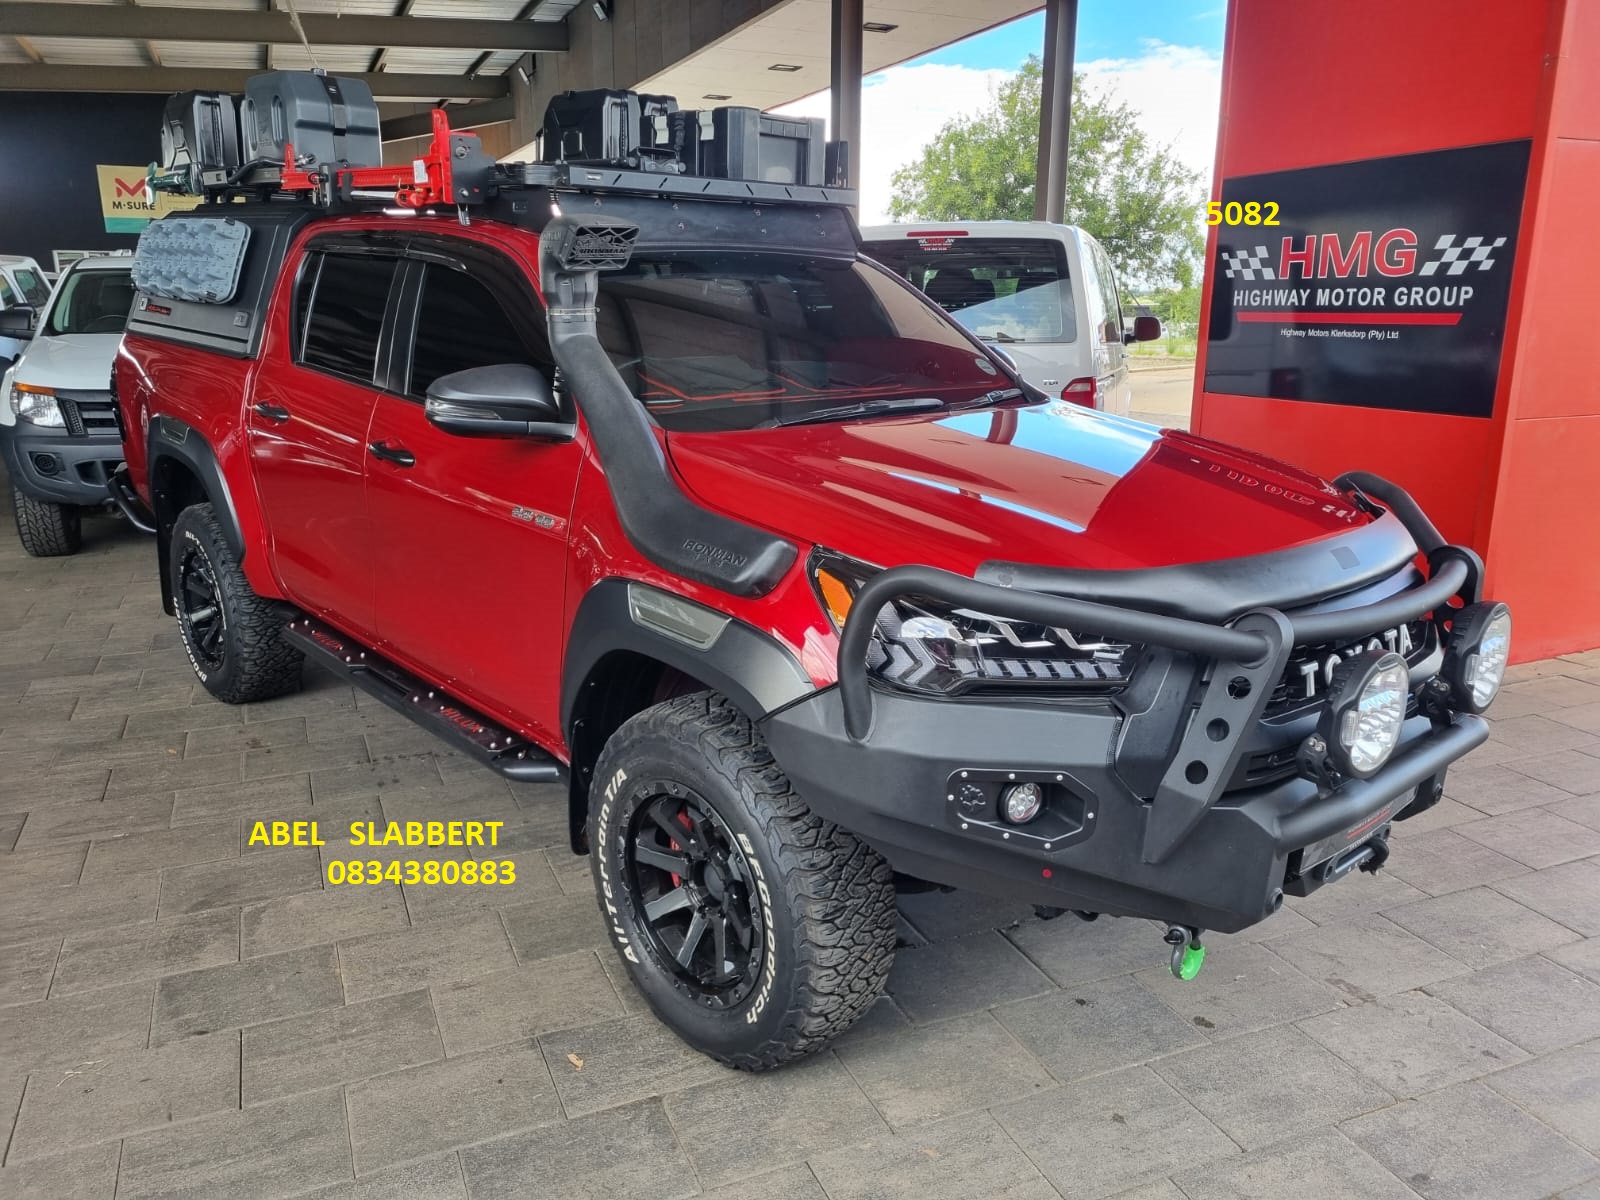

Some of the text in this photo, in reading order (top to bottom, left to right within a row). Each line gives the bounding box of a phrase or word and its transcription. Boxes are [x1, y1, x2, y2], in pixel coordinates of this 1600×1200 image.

[1278, 228, 1418, 280] HMG
[1233, 286, 1474, 307] HIGHWAY MOTOR GROUP
[1280, 328, 1399, 340] Highway Motors Klerksdorp (Pty) Ltd
[682, 539, 748, 568] IRONMAN
[1300, 623, 1414, 698] TTA
